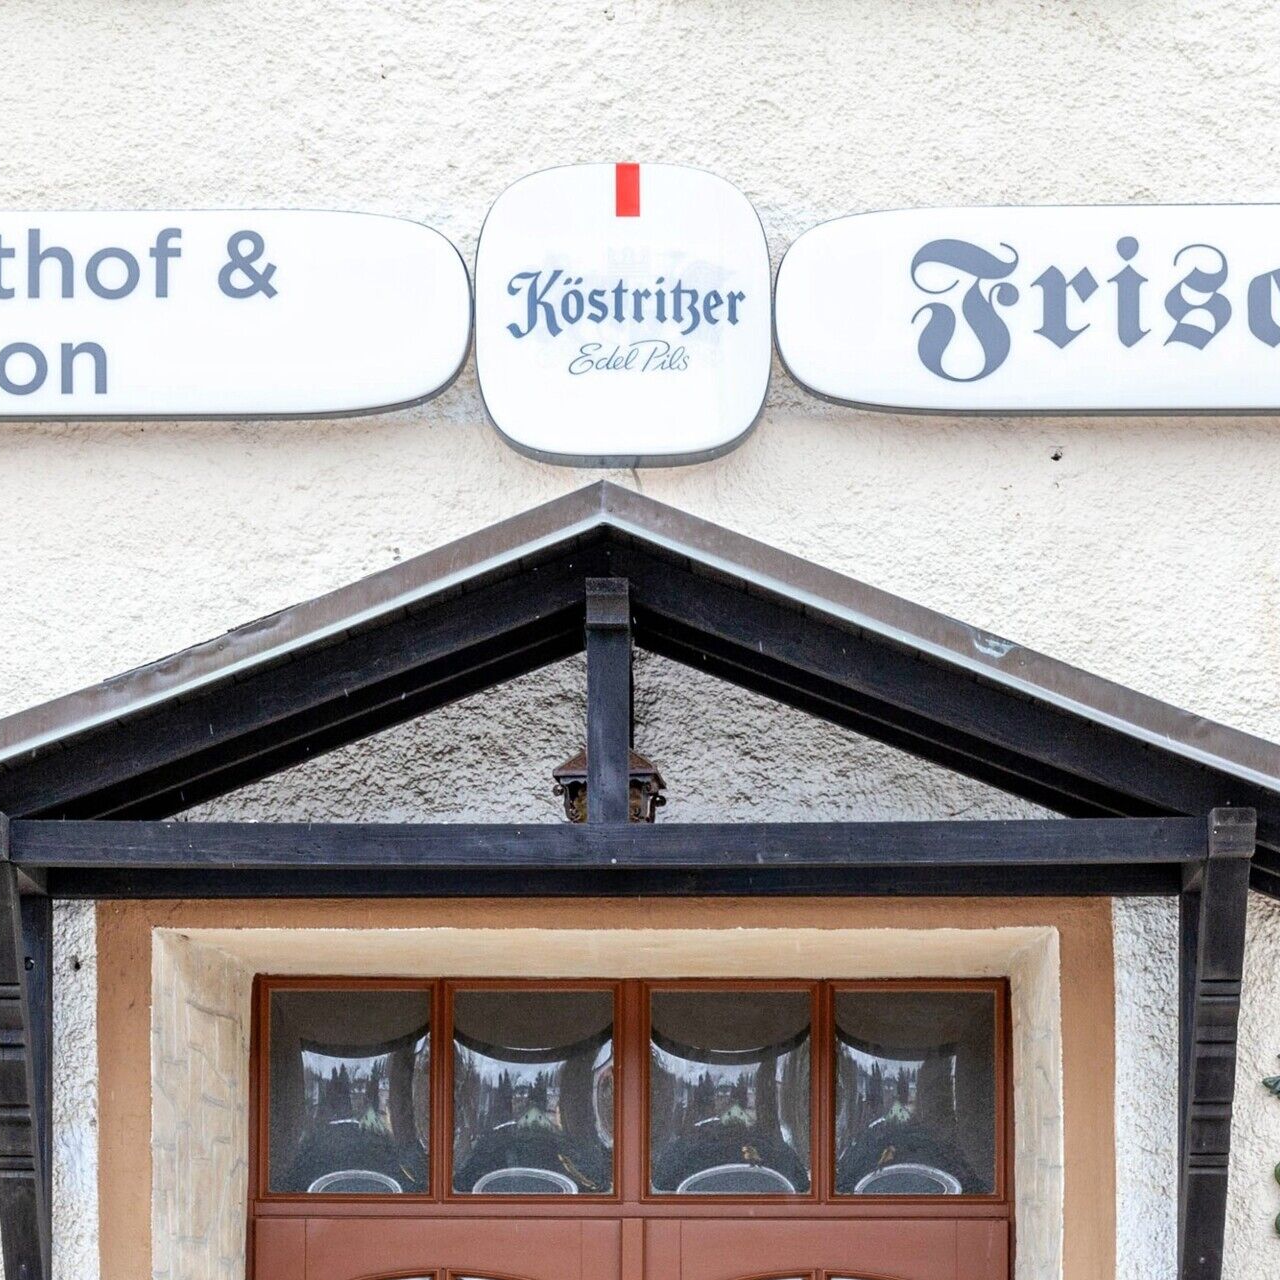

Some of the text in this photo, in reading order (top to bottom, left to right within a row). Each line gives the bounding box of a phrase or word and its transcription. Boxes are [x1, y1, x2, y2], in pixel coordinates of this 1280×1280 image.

[217, 229, 279, 300] &
[506, 269, 746, 339] Köstritzer
[568, 339, 690, 375] Edel Pils
